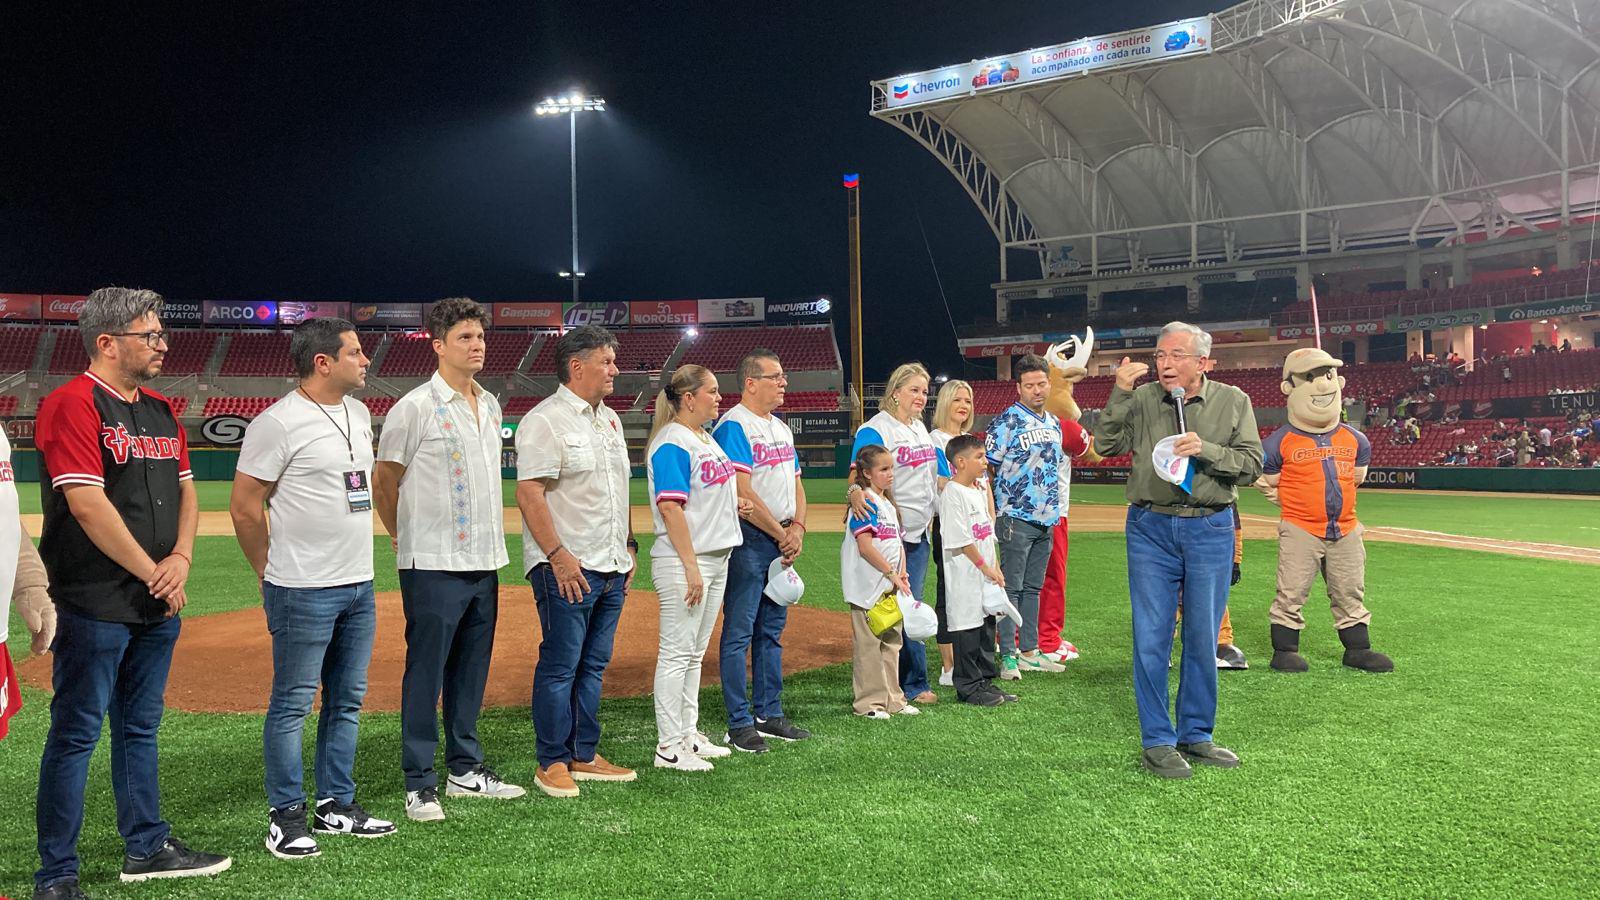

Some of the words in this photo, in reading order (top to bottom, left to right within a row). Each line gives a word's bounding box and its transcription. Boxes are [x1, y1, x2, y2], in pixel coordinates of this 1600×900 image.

[1045, 46, 1092, 61] confianz
[1096, 42, 1109, 52] de
[1111, 35, 1151, 49] sentirte
[1031, 57, 1090, 74] acompañado
[1106, 50, 1129, 60] cada
[1131, 46, 1151, 56] ruta
[912, 77, 960, 94] Chevron
[49, 300, 86, 313] Coca-Co
[209, 306, 254, 319] ARCO
[1526, 308, 1556, 318] Banco
[1557, 303, 1593, 314] Azteca
[568, 309, 618, 324] 105.1
[633, 313, 696, 323] NOROESTE
[1550, 395, 1595, 409] TENU
[1293, 446, 1355, 463] Gaspasa
